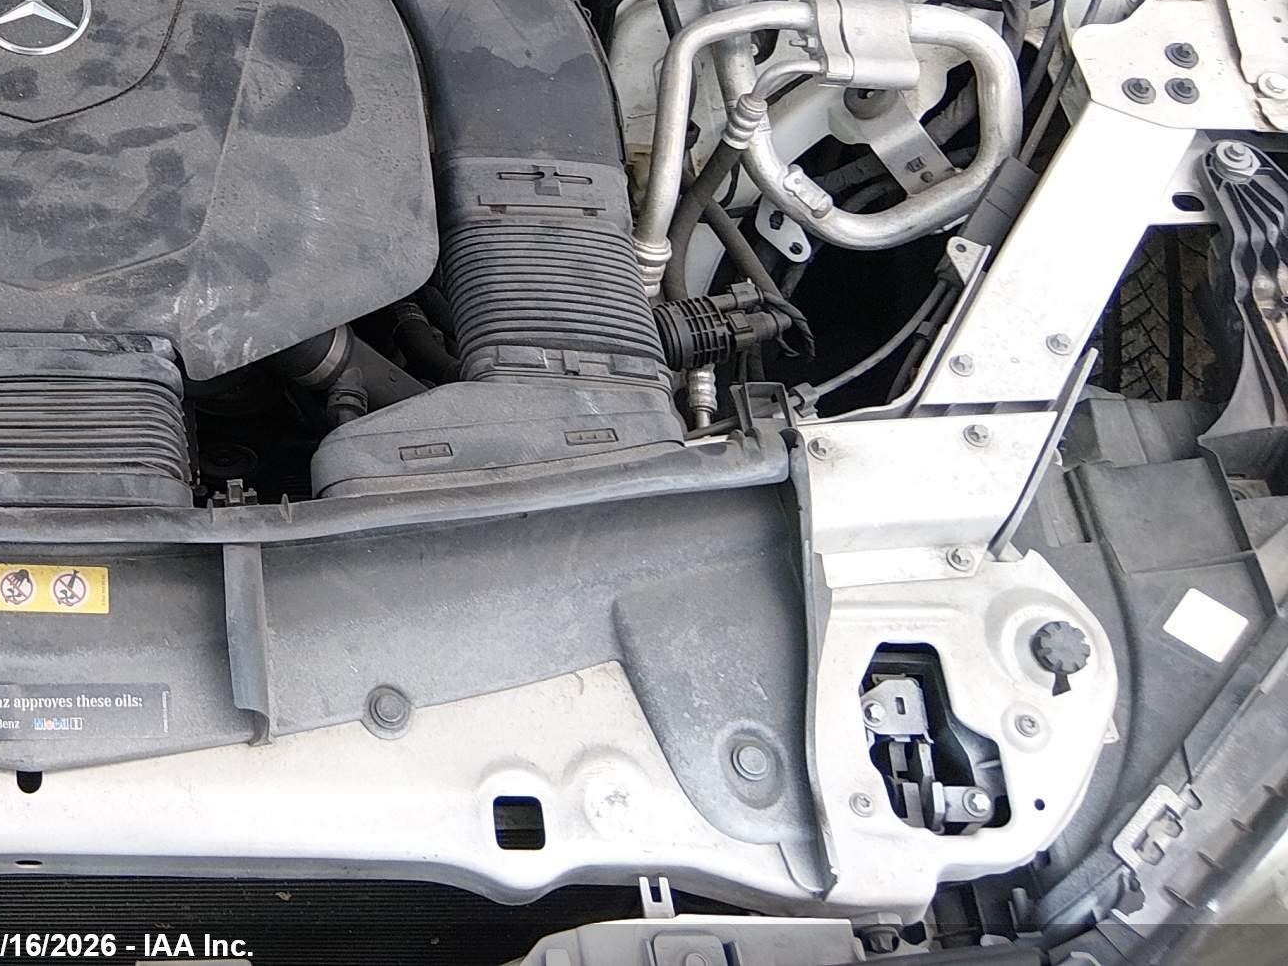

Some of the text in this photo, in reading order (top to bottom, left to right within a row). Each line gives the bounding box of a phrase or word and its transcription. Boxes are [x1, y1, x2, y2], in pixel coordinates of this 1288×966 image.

[13, 697, 73, 711] approves
[76, 695, 112, 707] these
[114, 694, 143, 708] oils:
[33, 717, 69, 731] Mobil
